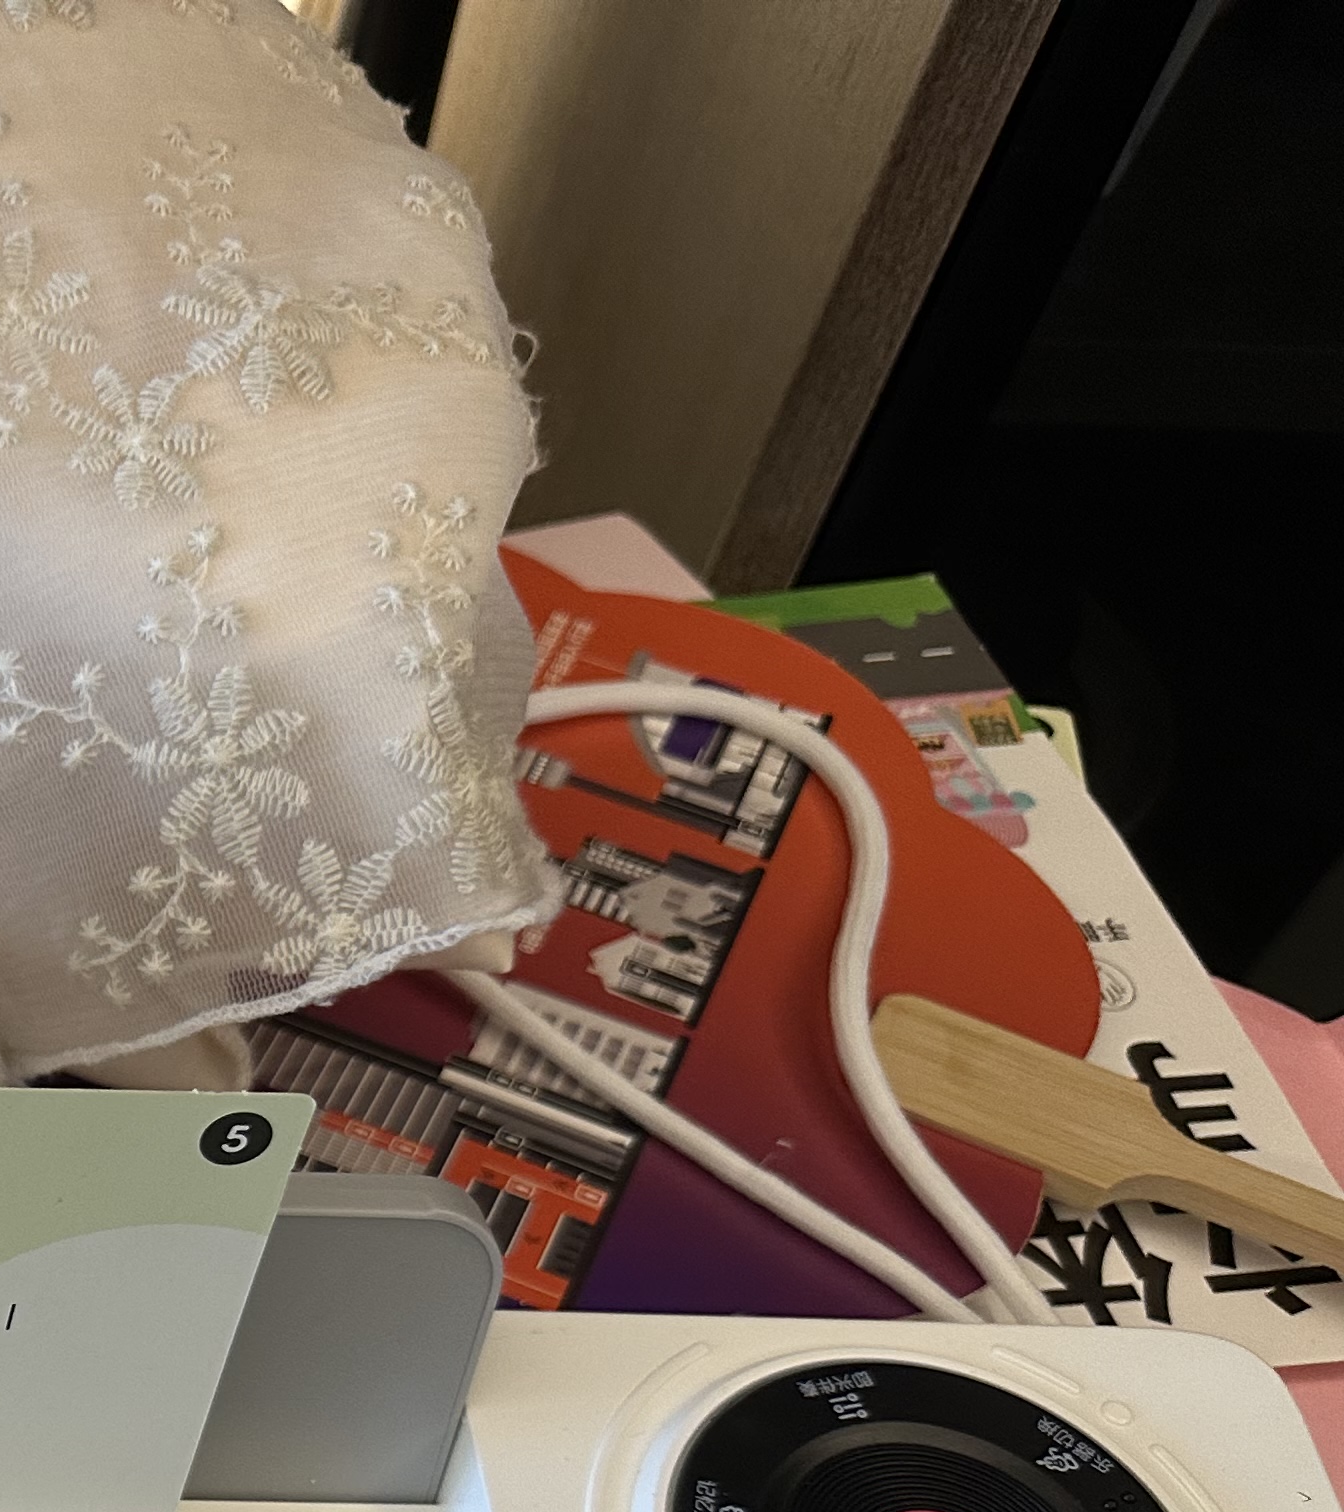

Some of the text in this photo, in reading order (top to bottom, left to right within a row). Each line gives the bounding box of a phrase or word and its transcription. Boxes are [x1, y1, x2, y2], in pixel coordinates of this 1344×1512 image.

[219, 1124, 250, 1154] 5
[1036, 1415, 1114, 1474] 乐器切换
